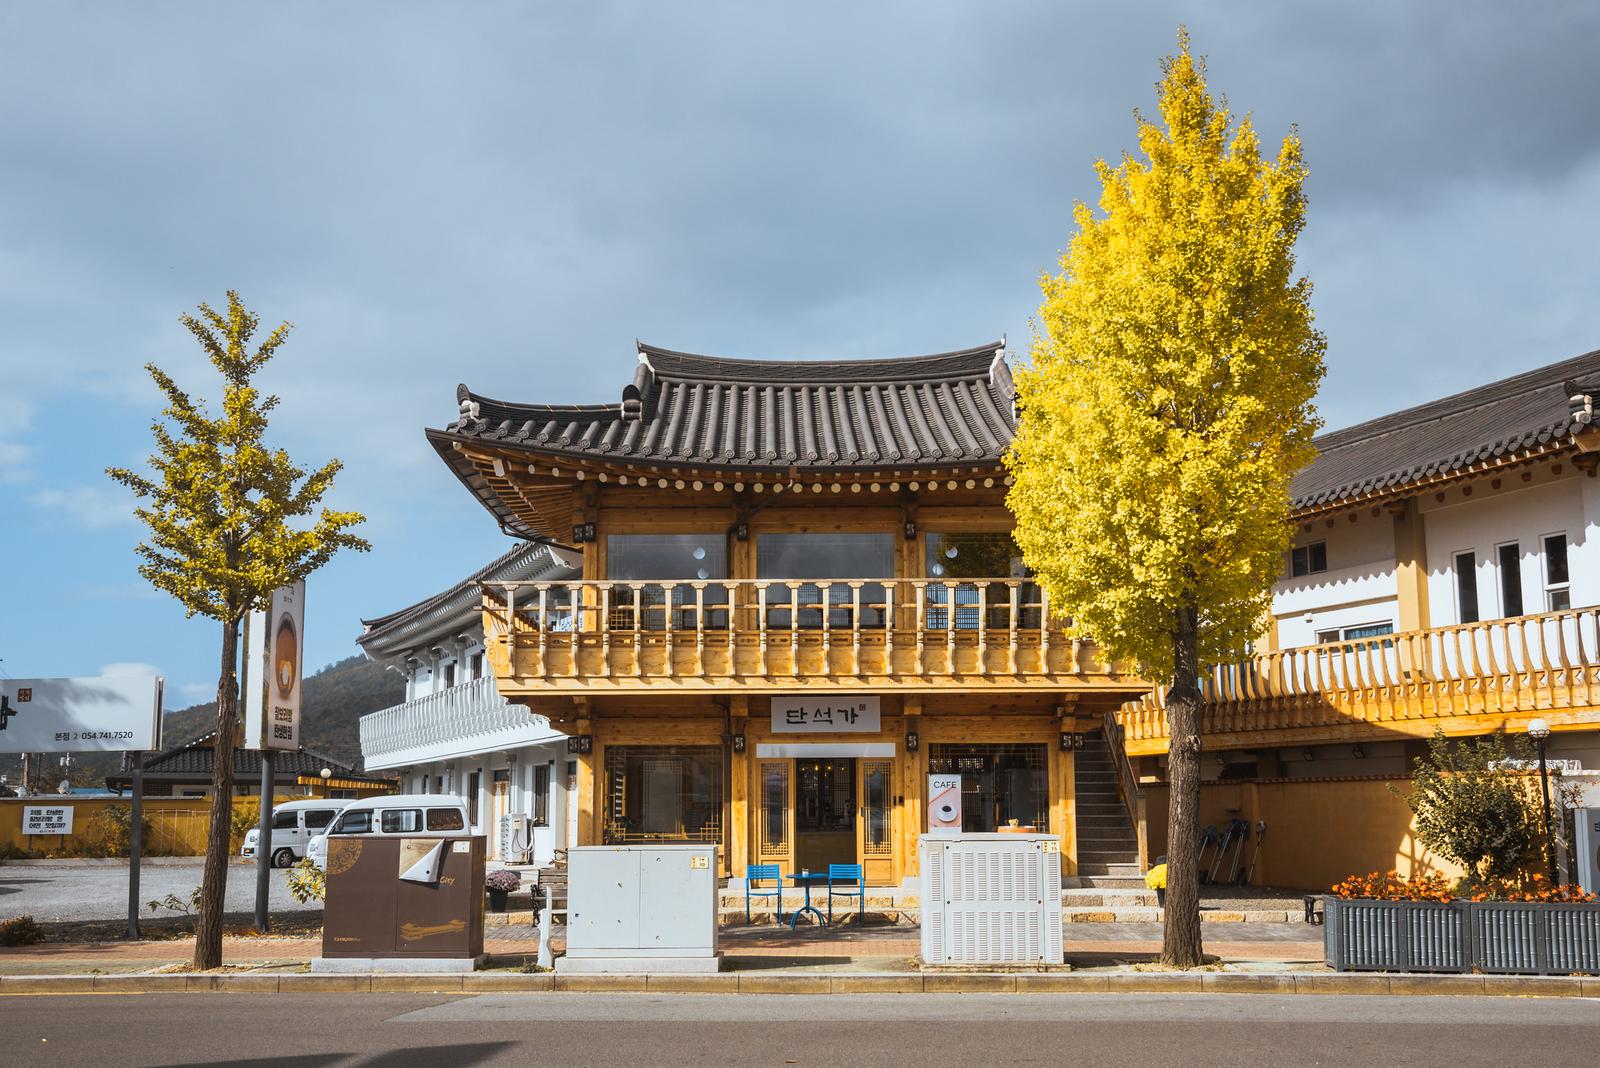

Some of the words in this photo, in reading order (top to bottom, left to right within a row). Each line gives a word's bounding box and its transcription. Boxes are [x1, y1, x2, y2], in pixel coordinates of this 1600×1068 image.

[786, 706, 859, 725] 단석가
[55, 732, 70, 741] 본점
[81, 731, 133, 740] 054.741.7520
[933, 781, 957, 789] CAFE
